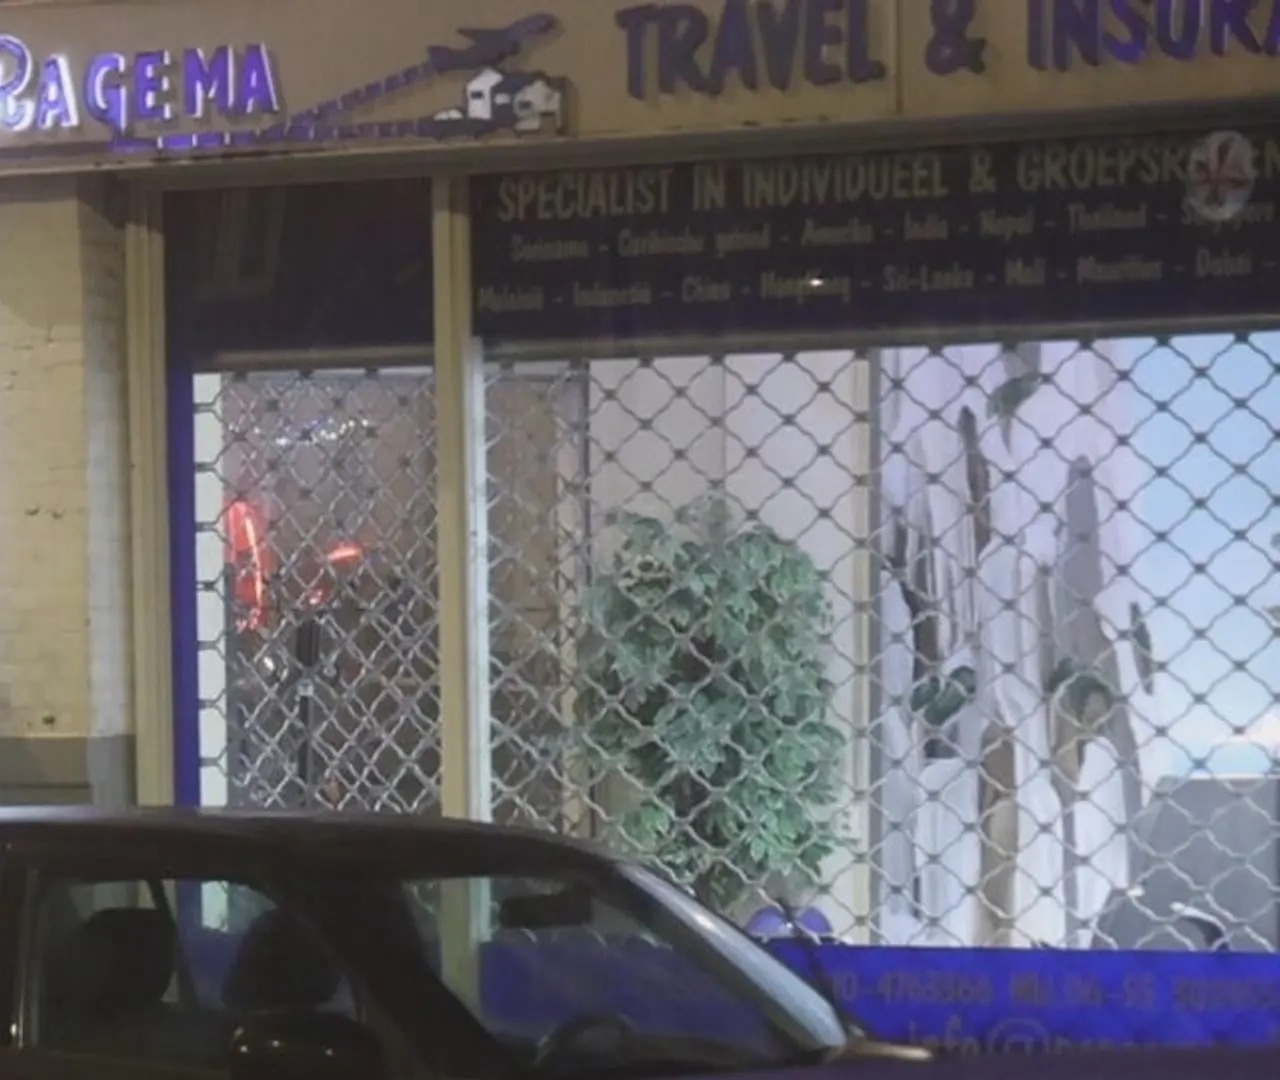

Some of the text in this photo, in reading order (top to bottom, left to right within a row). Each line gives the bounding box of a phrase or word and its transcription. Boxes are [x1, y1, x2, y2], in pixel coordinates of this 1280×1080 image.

[615, 0, 888, 100] TRAVEL
[924, 0, 986, 75] &
[496, 169, 673, 222] SPECIALIST
[692, 163, 726, 212] IN
[742, 152, 950, 209] INDIVIDUEEL
[968, 145, 997, 194] &
